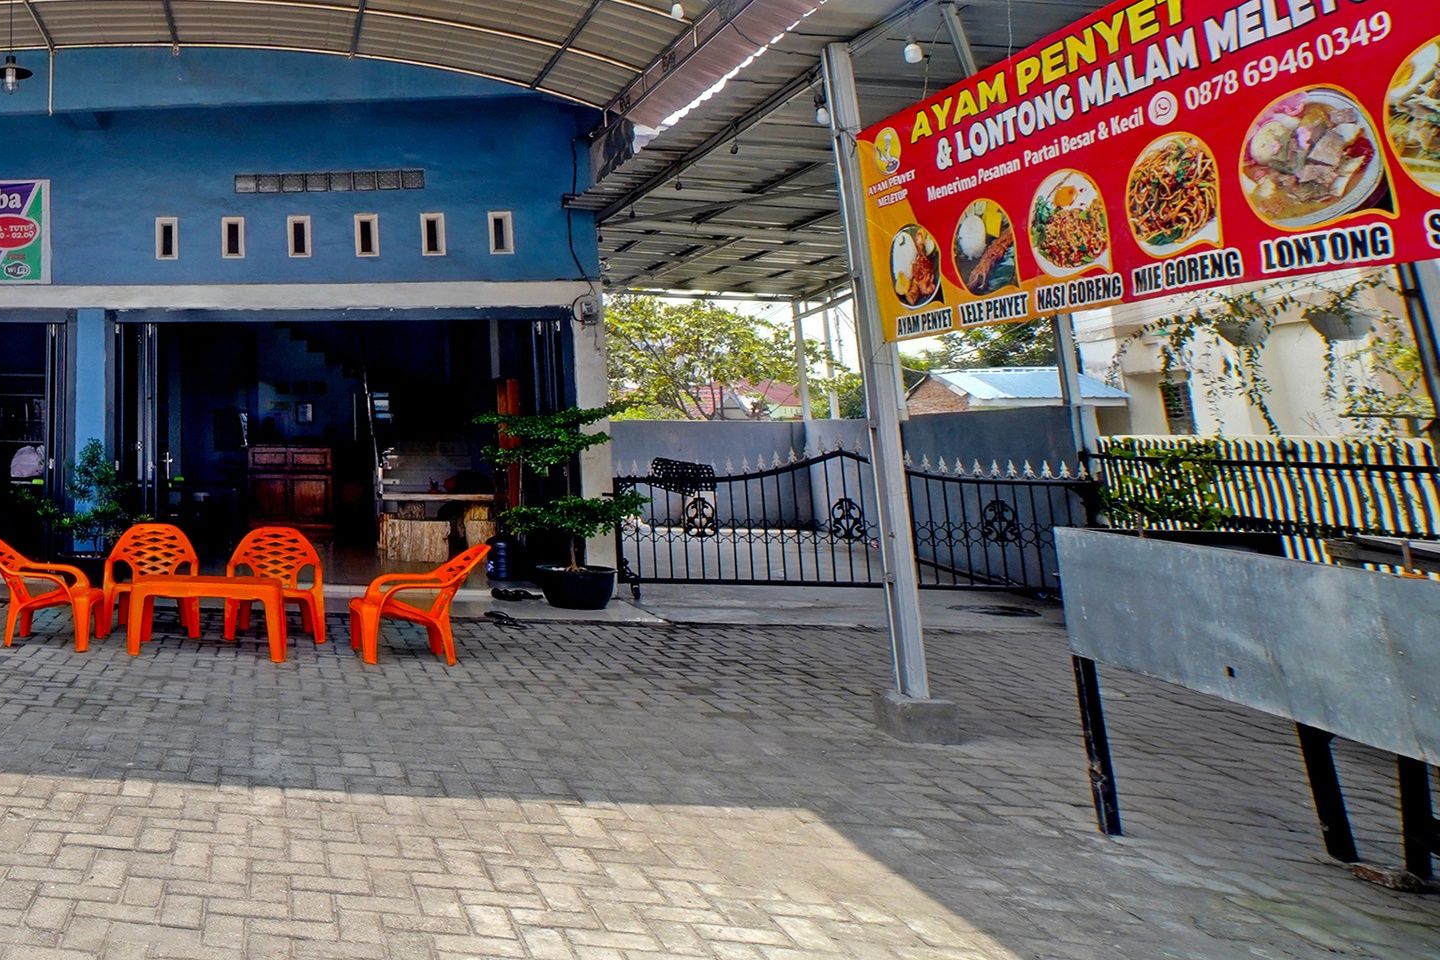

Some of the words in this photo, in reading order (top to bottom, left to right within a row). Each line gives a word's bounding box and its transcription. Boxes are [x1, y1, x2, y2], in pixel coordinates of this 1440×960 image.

[1184, 69, 1239, 110] 0878
[1243, 42, 1314, 87] 6946
[1315, 10, 1392, 61] 0349
[910, 72, 1008, 144] AYAM
[936, 137, 953, 171] &
[956, 84, 1074, 163] LONTONG
[1078, 26, 1200, 113] MALAM
[926, 176, 977, 202] Menerima
[977, 158, 1021, 185] Pesanan
[1024, 139, 1060, 168] Partai
[1062, 129, 1096, 155] Besar
[1097, 121, 1109, 140] &
[1110, 107, 1144, 136] Kecil
[867, 181, 888, 196] AYAM
[888, 169, 916, 187] PENYET
[877, 188, 908, 207] MELETOP
[1262, 225, 1391, 271] LONTONG
[1037, 285, 1066, 310] NASI
[1068, 275, 1122, 304] GORENG
[1134, 262, 1160, 294] MIE
[1164, 251, 1241, 287] GORENG
[897, 314, 920, 336] AYAM
[921, 308, 952, 333] PENYET
[960, 301, 986, 324] LELE
[986, 294, 1028, 320] PENYET
